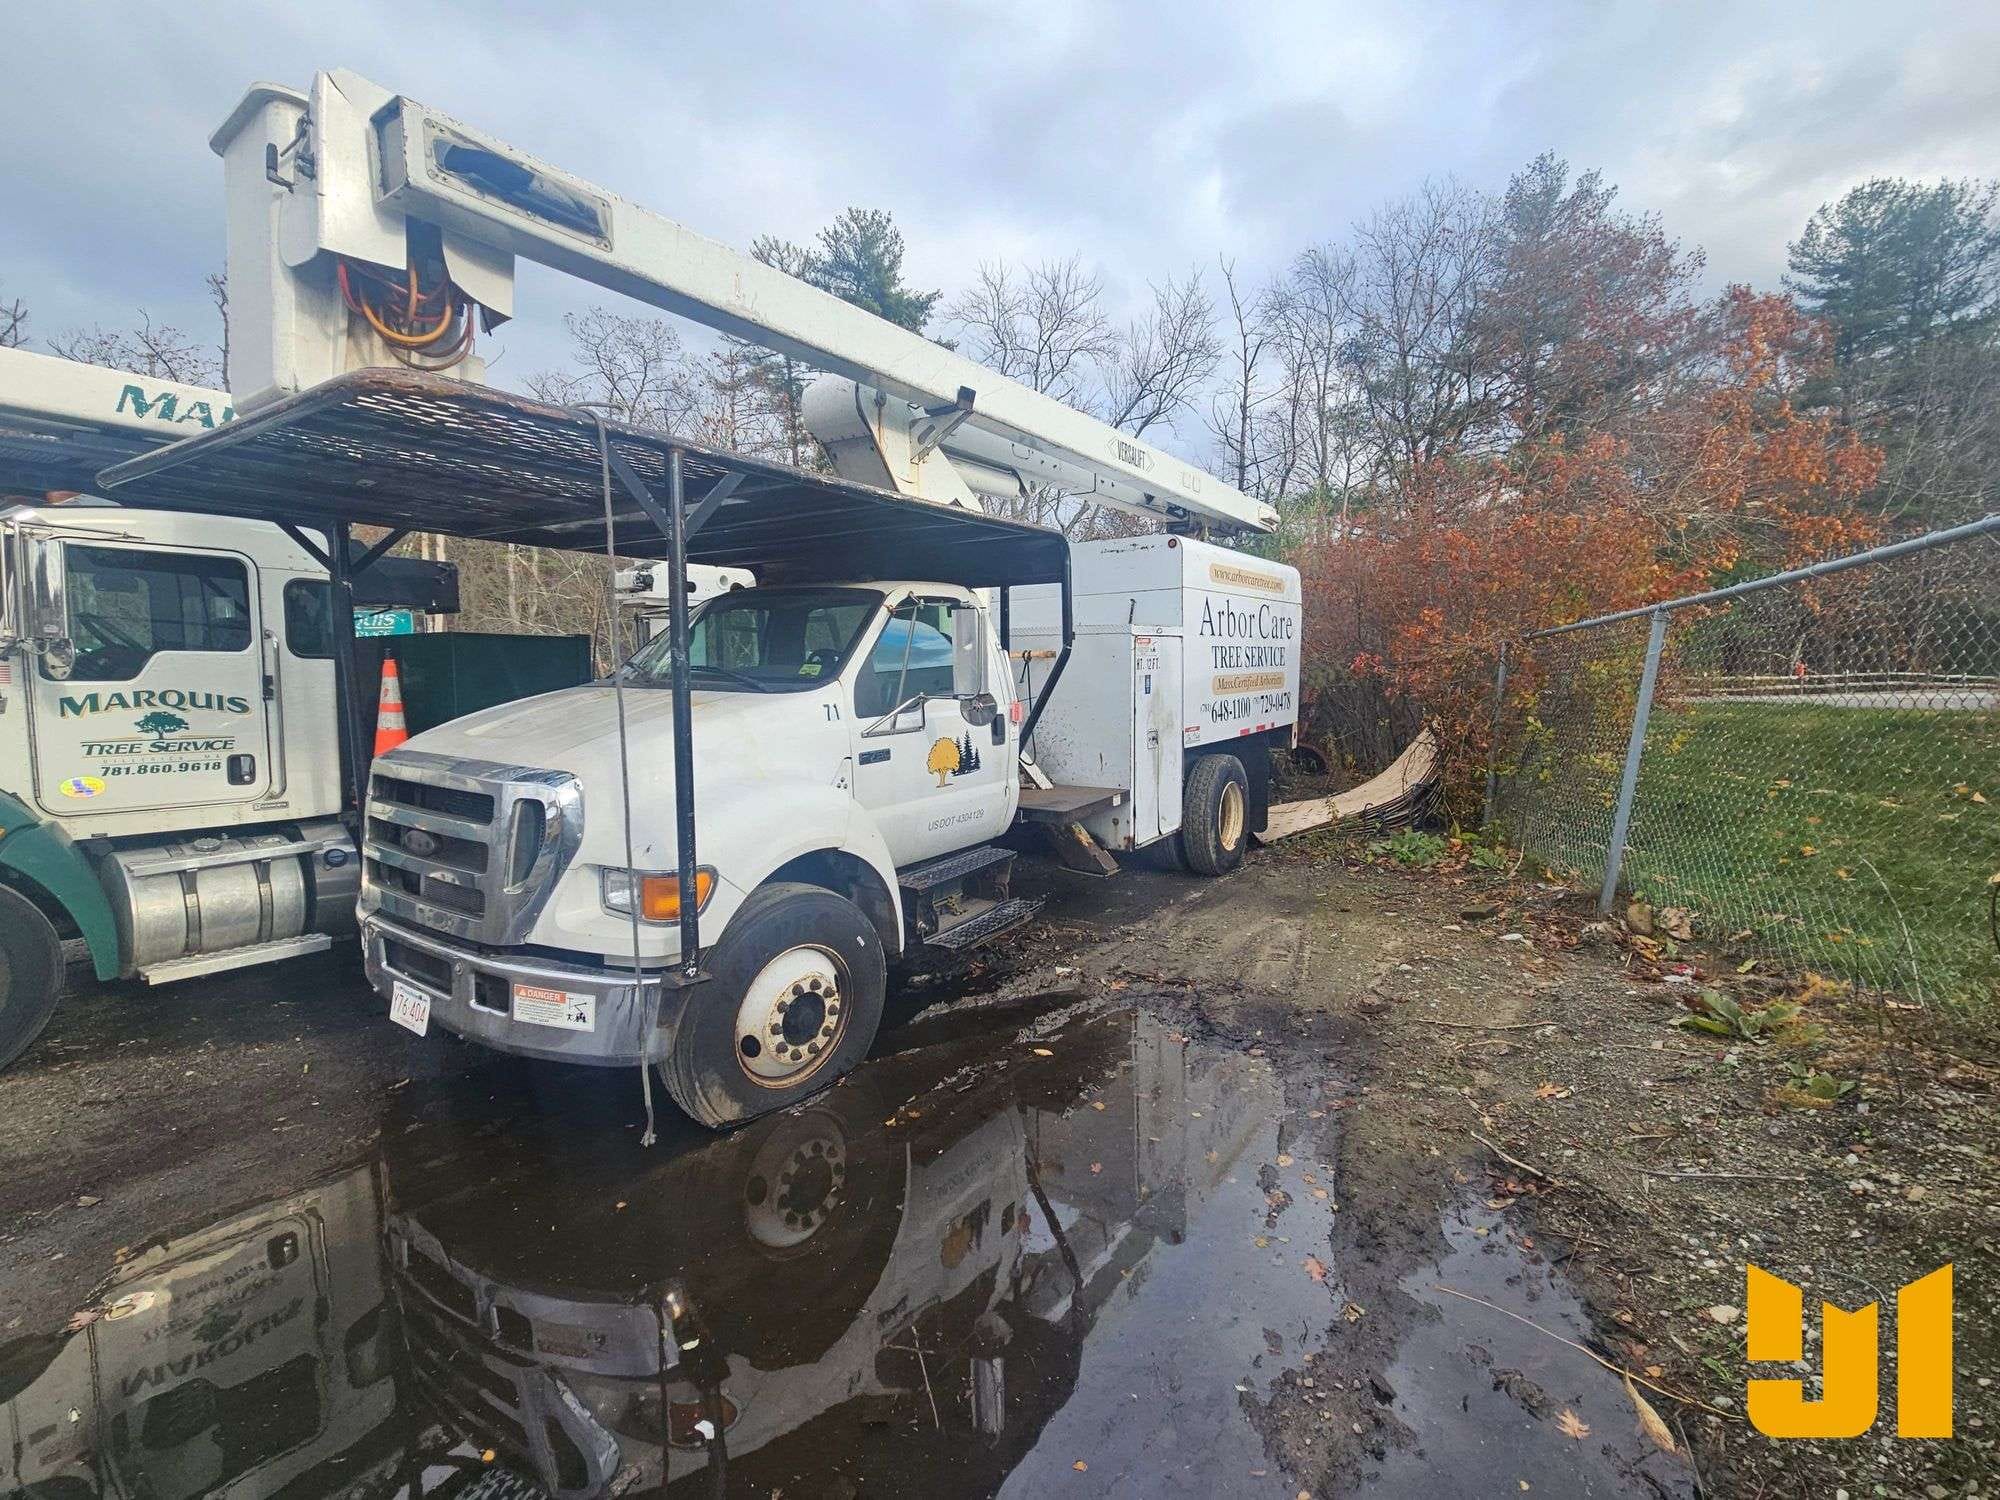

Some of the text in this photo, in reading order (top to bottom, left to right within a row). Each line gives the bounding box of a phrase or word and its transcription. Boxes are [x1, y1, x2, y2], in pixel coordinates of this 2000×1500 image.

[1212, 645, 1286, 668] TREE SERVICE
[58, 689, 250, 718] MARQUIS
[823, 703, 840, 721] 71
[1211, 696, 1251, 723] 648-1100
[1260, 691, 1291, 715] 729-0478
[81, 739, 236, 756] TREE SERVICE
[101, 761, 221, 777] 781.860.9618
[527, 988, 561, 1003] DANGER
